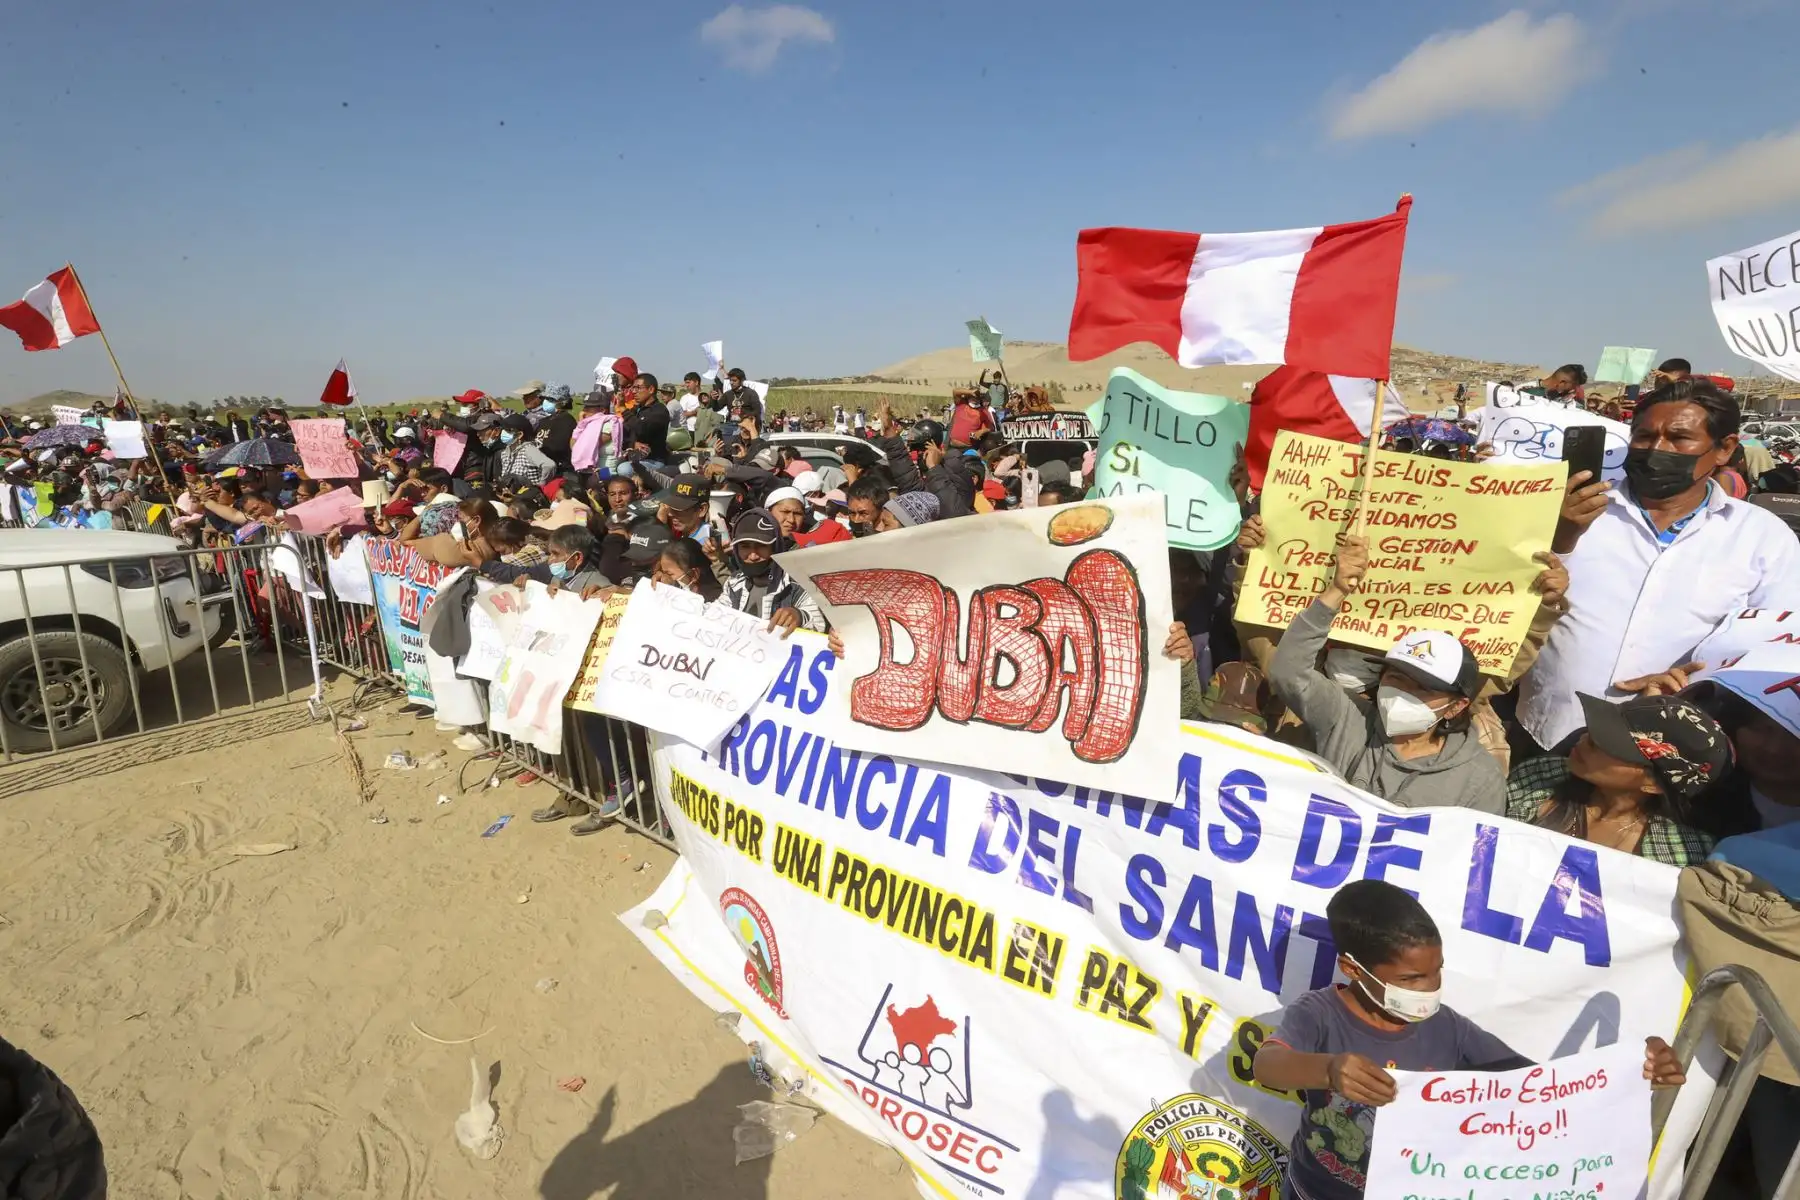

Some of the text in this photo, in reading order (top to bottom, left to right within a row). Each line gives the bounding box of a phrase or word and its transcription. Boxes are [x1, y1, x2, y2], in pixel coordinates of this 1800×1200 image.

[677, 484, 692, 495] CAT
[1463, 581, 1514, 595] UNA
[809, 549, 1147, 763] DUBAI
[701, 713, 951, 857] ROVINCIA
[968, 791, 1094, 914] DEL
[1291, 793, 1431, 901] DE
[1461, 823, 1611, 967] LA
[724, 802, 763, 861] POR
[773, 826, 822, 893] UNA
[827, 851, 994, 970] PROVINCIA
[1004, 922, 1063, 994] EN
[1079, 951, 1156, 1030] PAZ
[1182, 995, 1212, 1056] Y
[1421, 1067, 1608, 1104] Castillo Estamos
[1145, 1102, 1210, 1138] POLICIA
[1184, 1126, 1258, 1164] DEL PERU
[1464, 1164, 1559, 1180] acceso
[1572, 1153, 1613, 1185] para
